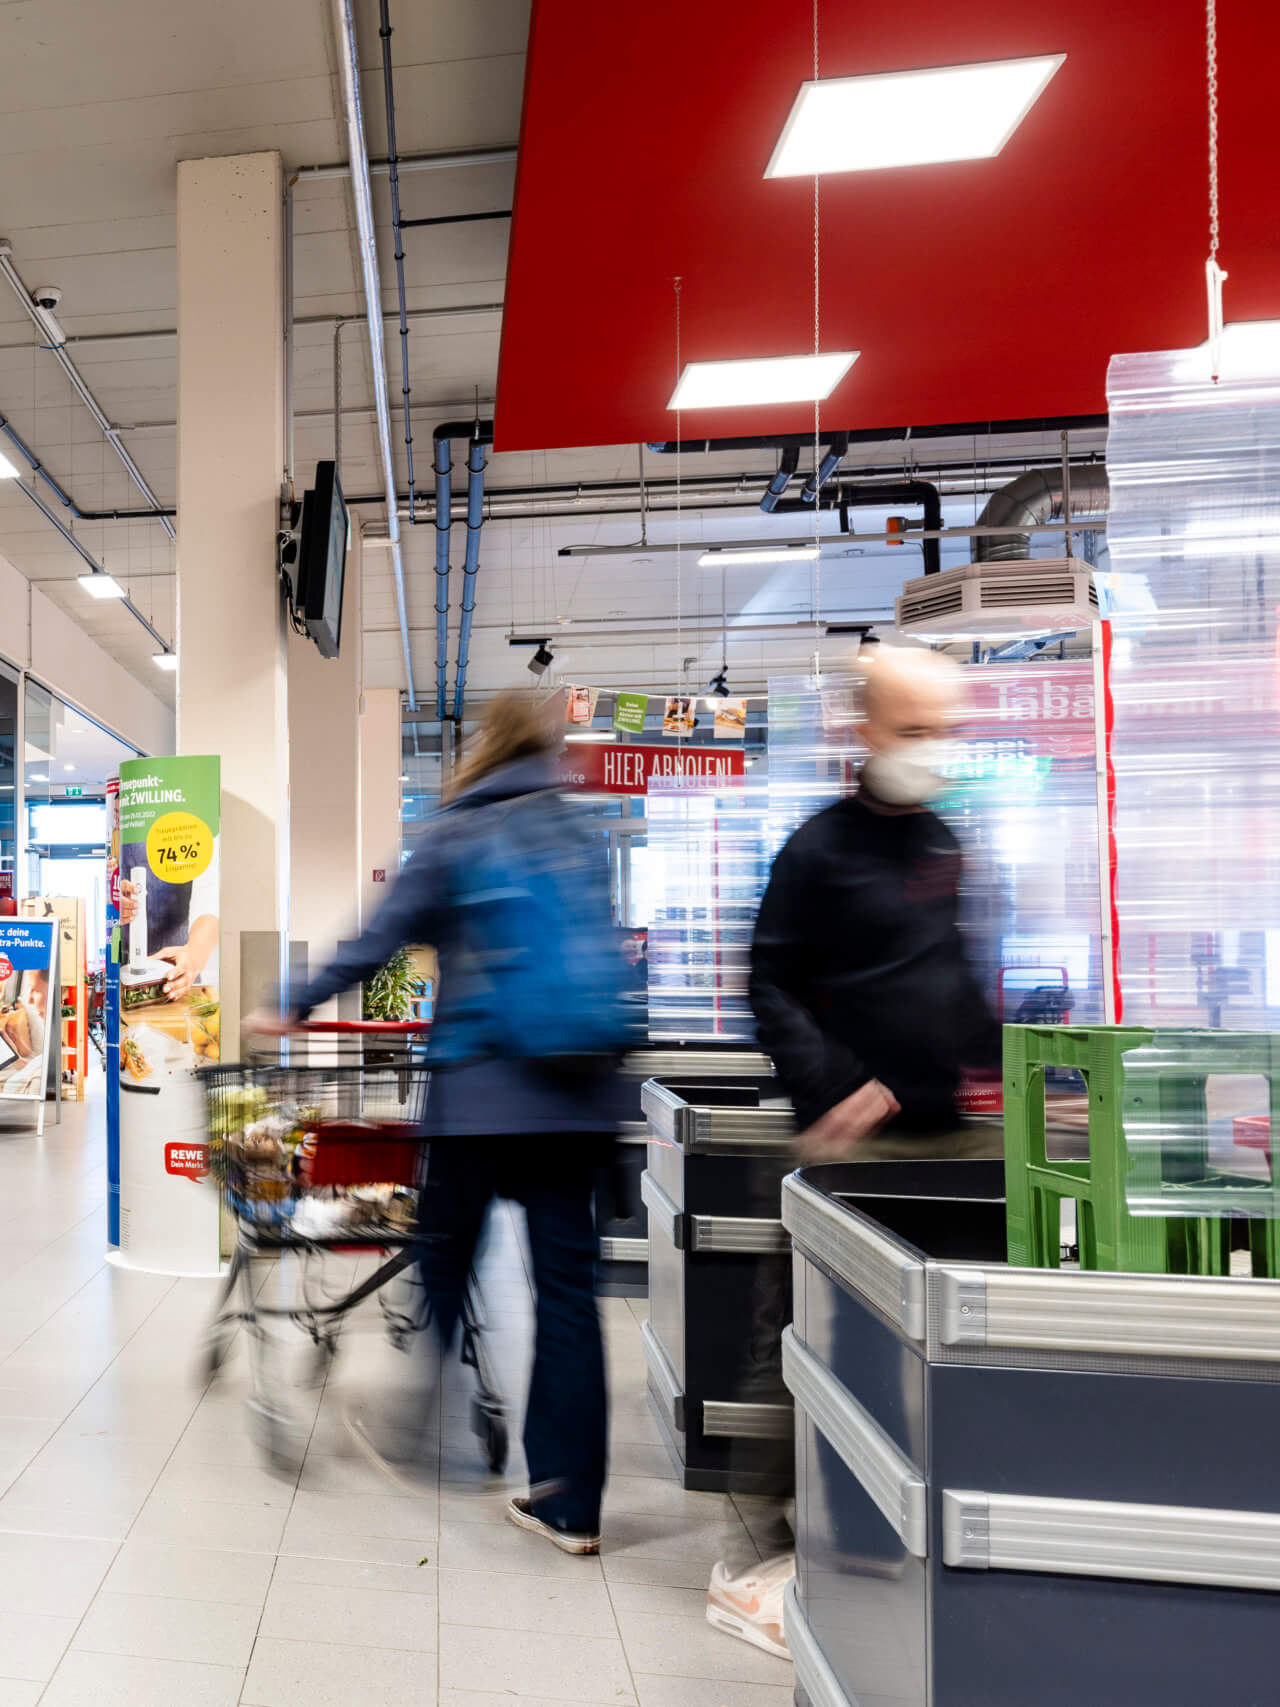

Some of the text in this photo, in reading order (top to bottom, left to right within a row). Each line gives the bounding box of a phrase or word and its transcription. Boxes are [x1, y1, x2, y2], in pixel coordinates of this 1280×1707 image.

[604, 751, 645, 787] HIER
[130, 789, 186, 805] ZWILLING.
[6, 928, 29, 936] deine
[171, 1149, 204, 1160] REWE
